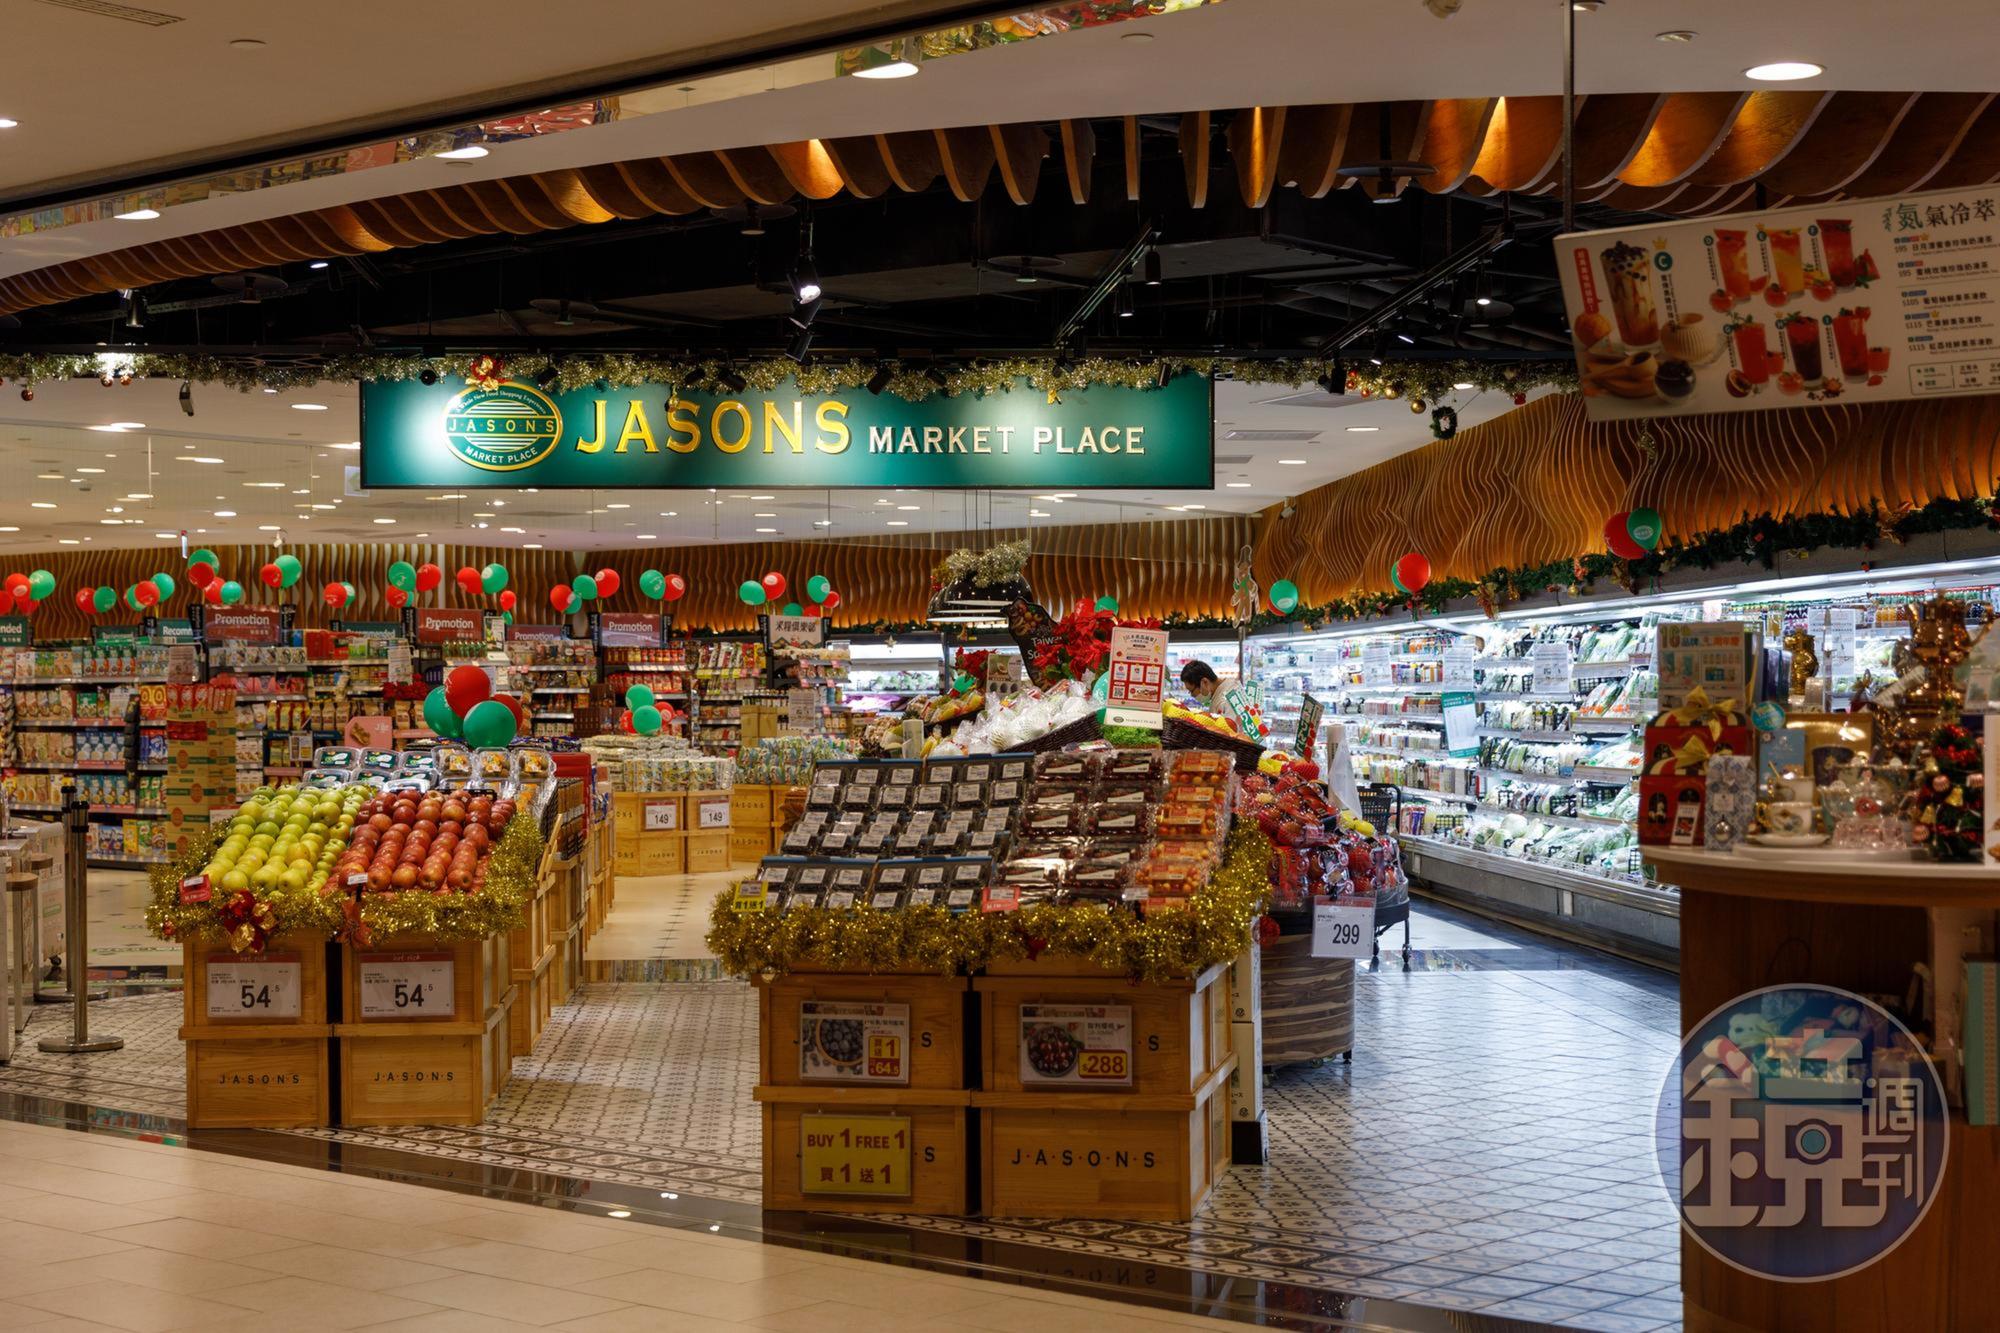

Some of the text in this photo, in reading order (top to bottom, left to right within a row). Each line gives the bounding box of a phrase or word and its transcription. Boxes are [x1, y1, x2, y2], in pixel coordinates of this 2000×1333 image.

[1896, 198, 1996, 232] 氮氣冷萃
[1658, 255, 1668, 268] C
[500, 391, 523, 400] Shopping
[523, 395, 547, 415] Experience
[576, 400, 851, 454] JASONS
[868, 426, 1145, 454] MARKET PLACE
[465, 446, 538, 463] MARKET PLACE
[215, 613, 270, 626] Promotion
[426, 617, 474, 630] Promotion
[609, 621, 653, 633] Promotion
[1031, 635, 1062, 647] Taiw
[655, 814, 669, 824] 149
[709, 812, 722, 822] 149
[1332, 923, 1360, 944] 299
[807, 1127, 905, 1149] BUY 1 FREE 1
[820, 1163, 890, 1184] 買 1 送 1
